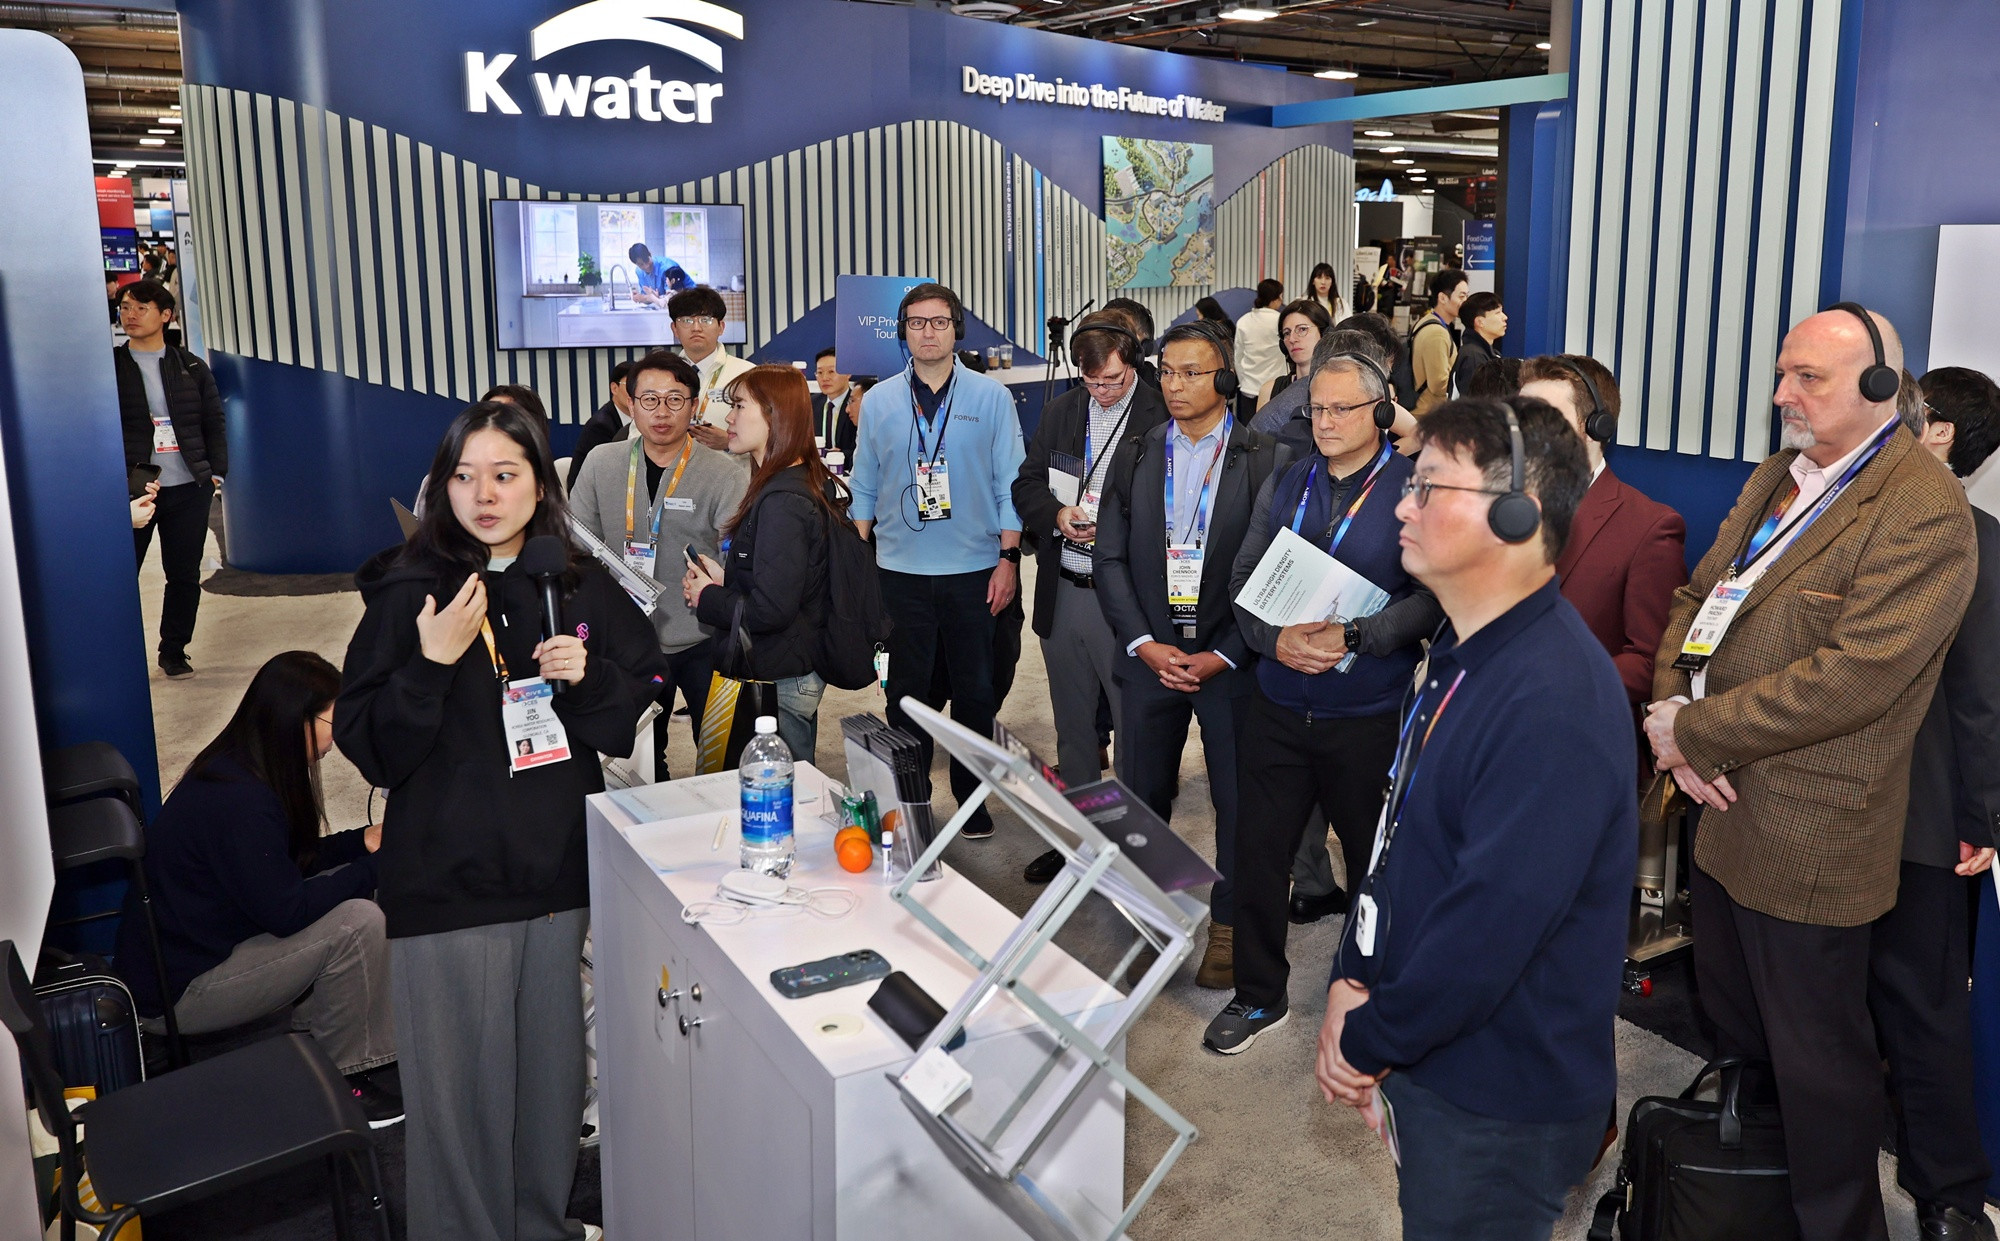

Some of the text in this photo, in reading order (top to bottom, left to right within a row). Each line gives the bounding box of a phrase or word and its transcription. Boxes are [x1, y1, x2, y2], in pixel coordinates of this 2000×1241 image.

[462, 50, 724, 123] K water
[962, 66, 1226, 122] Deep Dive into the Future of Water
[858, 316, 898, 327] VIP Priv
[874, 328, 898, 339] Tour
[1301, 487, 1310, 506] SONY
[1819, 485, 1840, 510] SONY
[1254, 548, 1292, 606] ULTRA-HIGH DENSITY
[1260, 585, 1278, 610] BATTERY
[1276, 560, 1294, 586] SYSTEMS
[742, 808, 779, 822] QUAFINA
